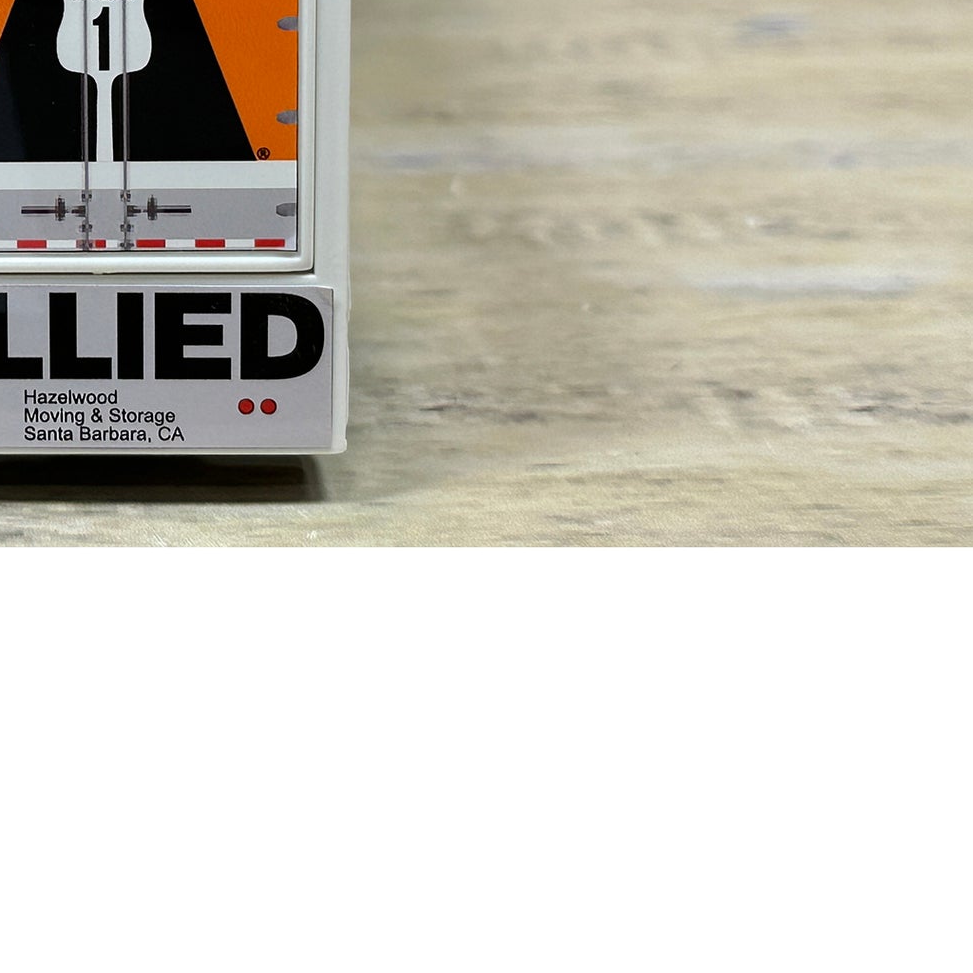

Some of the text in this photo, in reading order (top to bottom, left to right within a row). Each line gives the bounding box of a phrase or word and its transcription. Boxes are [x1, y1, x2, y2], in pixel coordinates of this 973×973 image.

[92, 6, 110, 71] 1
[24, 389, 118, 405] Hazelwood
[24, 408, 176, 426] Moving & Storage
[24, 426, 185, 443] Santa Barbara, CA
